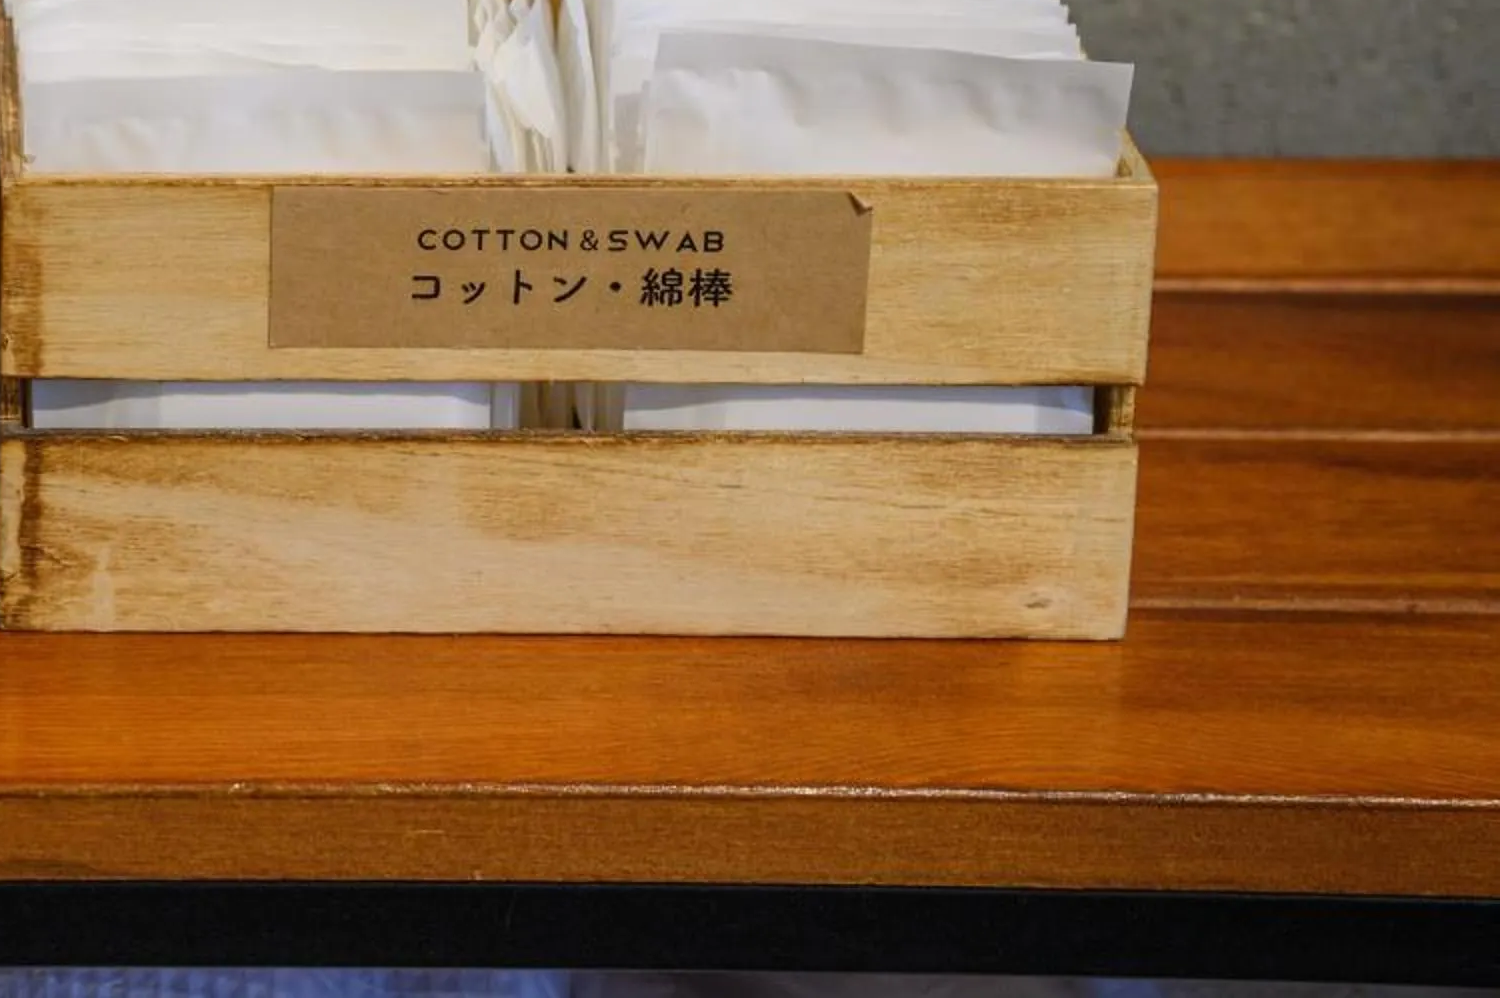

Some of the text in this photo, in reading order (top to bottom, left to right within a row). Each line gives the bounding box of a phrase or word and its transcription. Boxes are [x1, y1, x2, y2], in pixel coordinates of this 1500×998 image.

[417, 229, 568, 252] COTTON
[607, 229, 726, 253] SWAB
[412, 267, 733, 308] コットン・綿棒
